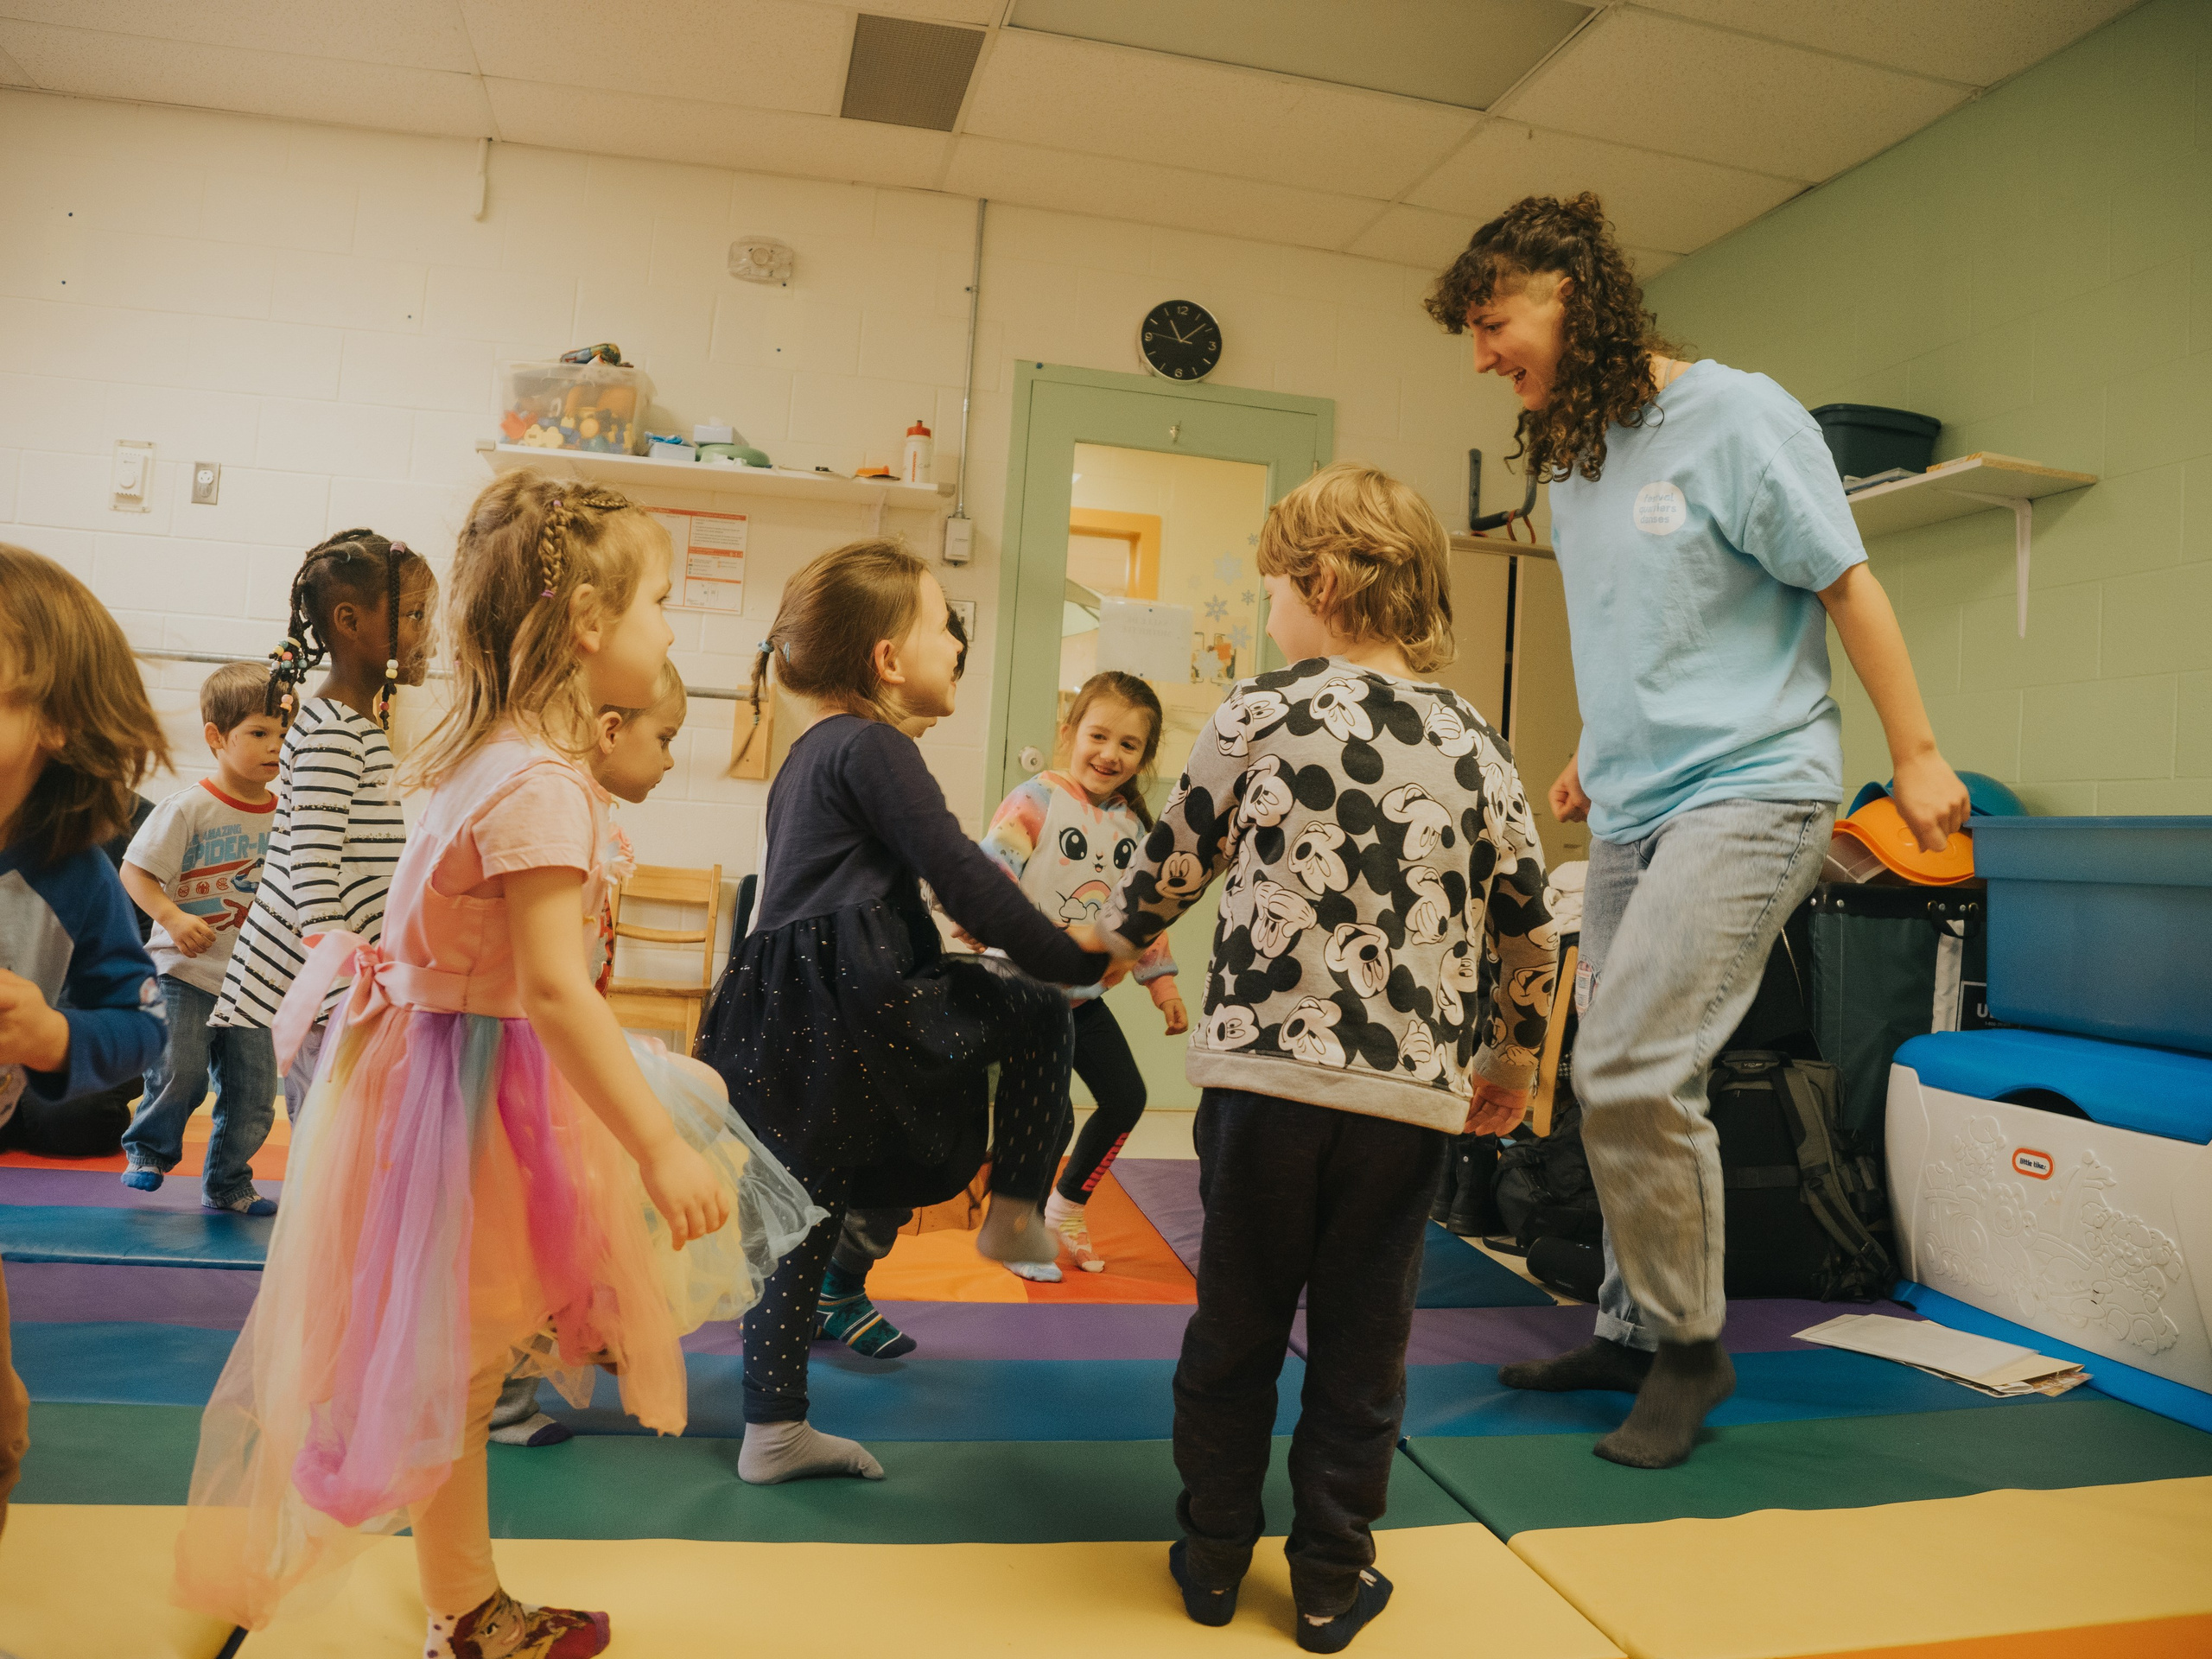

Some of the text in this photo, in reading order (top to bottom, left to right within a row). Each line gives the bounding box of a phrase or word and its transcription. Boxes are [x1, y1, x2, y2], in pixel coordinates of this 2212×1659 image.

[1177, 306, 1189, 315] 12
[1144, 332, 1153, 341] 9
[1208, 341, 1217, 351] 3
[1174, 368, 1183, 378] 6
[1640, 515, 1670, 524] danses
[2019, 1157, 2032, 1166] little
